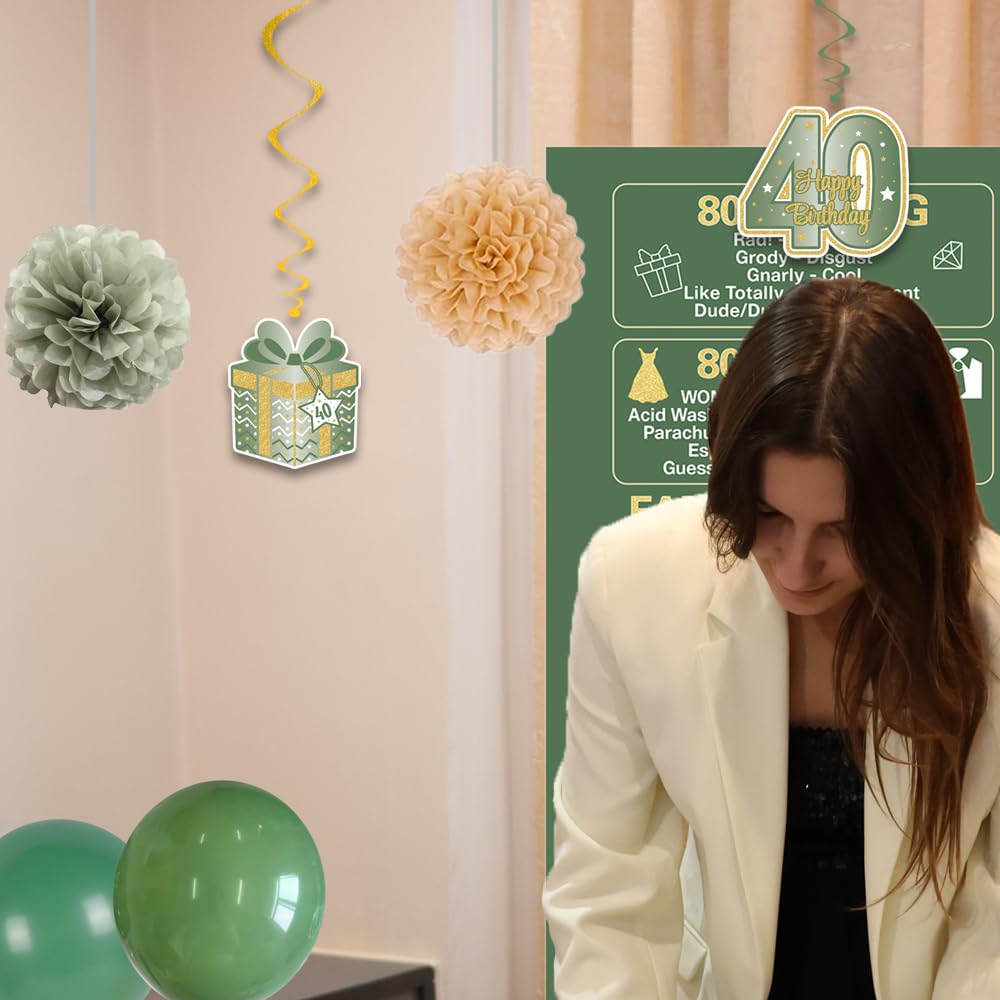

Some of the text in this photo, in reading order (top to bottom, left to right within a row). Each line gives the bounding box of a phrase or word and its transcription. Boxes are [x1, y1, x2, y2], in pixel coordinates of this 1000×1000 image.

[742, 110, 906, 256] 40
[794, 169, 863, 201] Happy
[697, 194, 738, 227] 80
[785, 202, 871, 235] Birthday
[735, 250, 788, 268] Grody
[747, 267, 804, 285] Gnarly
[684, 285, 720, 300] Like
[694, 303, 765, 318] Dude/D
[697, 347, 738, 380] 80
[315, 402, 332, 420] 40
[628, 407, 711, 422] Acid Was
